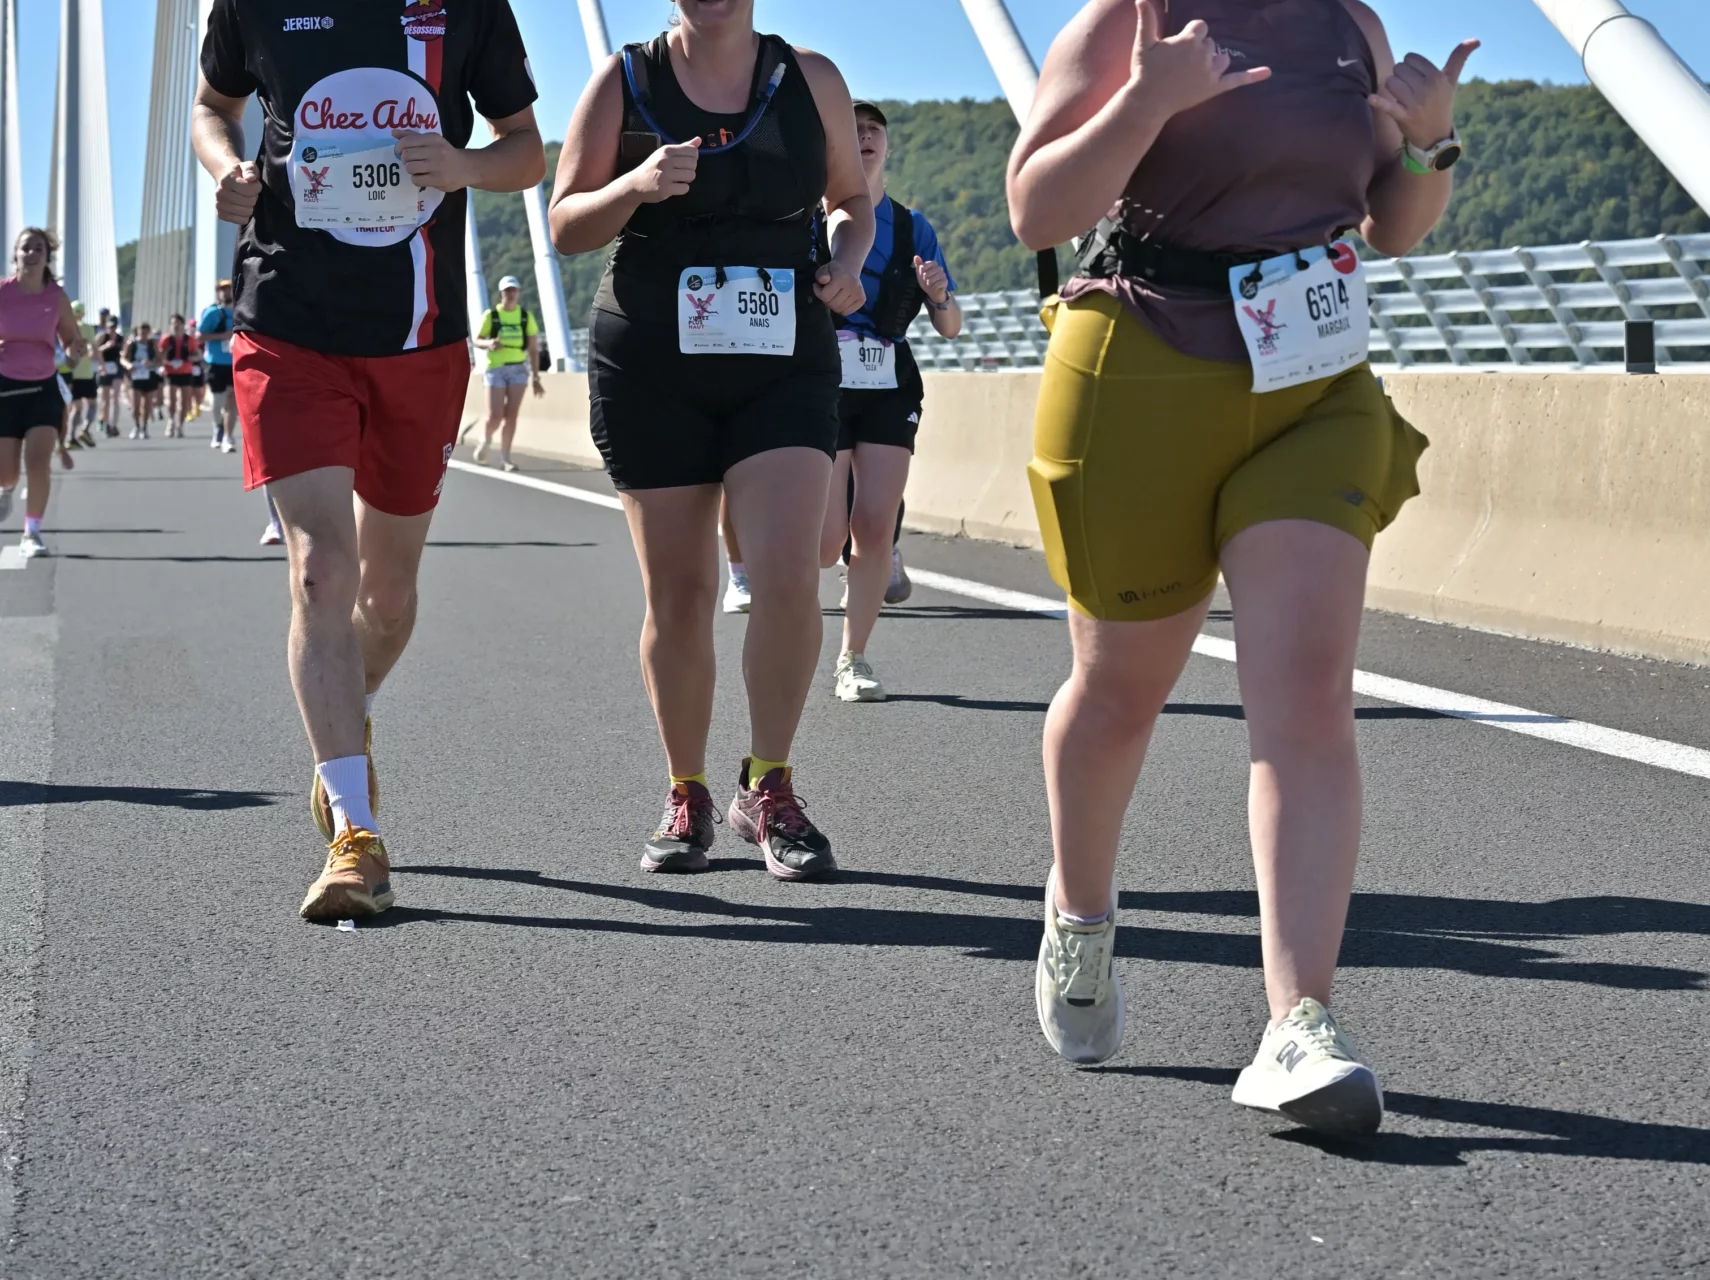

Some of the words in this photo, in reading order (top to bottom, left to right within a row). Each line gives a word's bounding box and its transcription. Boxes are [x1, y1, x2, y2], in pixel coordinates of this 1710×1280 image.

[283, 17, 321, 31] JERSIX
[300, 96, 368, 130] Chez
[372, 96, 438, 130] Adou
[352, 163, 400, 189] 5306
[368, 190, 386, 201] LOIC
[738, 291, 779, 316] 5580
[1305, 278, 1349, 321] 6574
[749, 318, 770, 328] ANAIS
[859, 347, 882, 363] 9177
